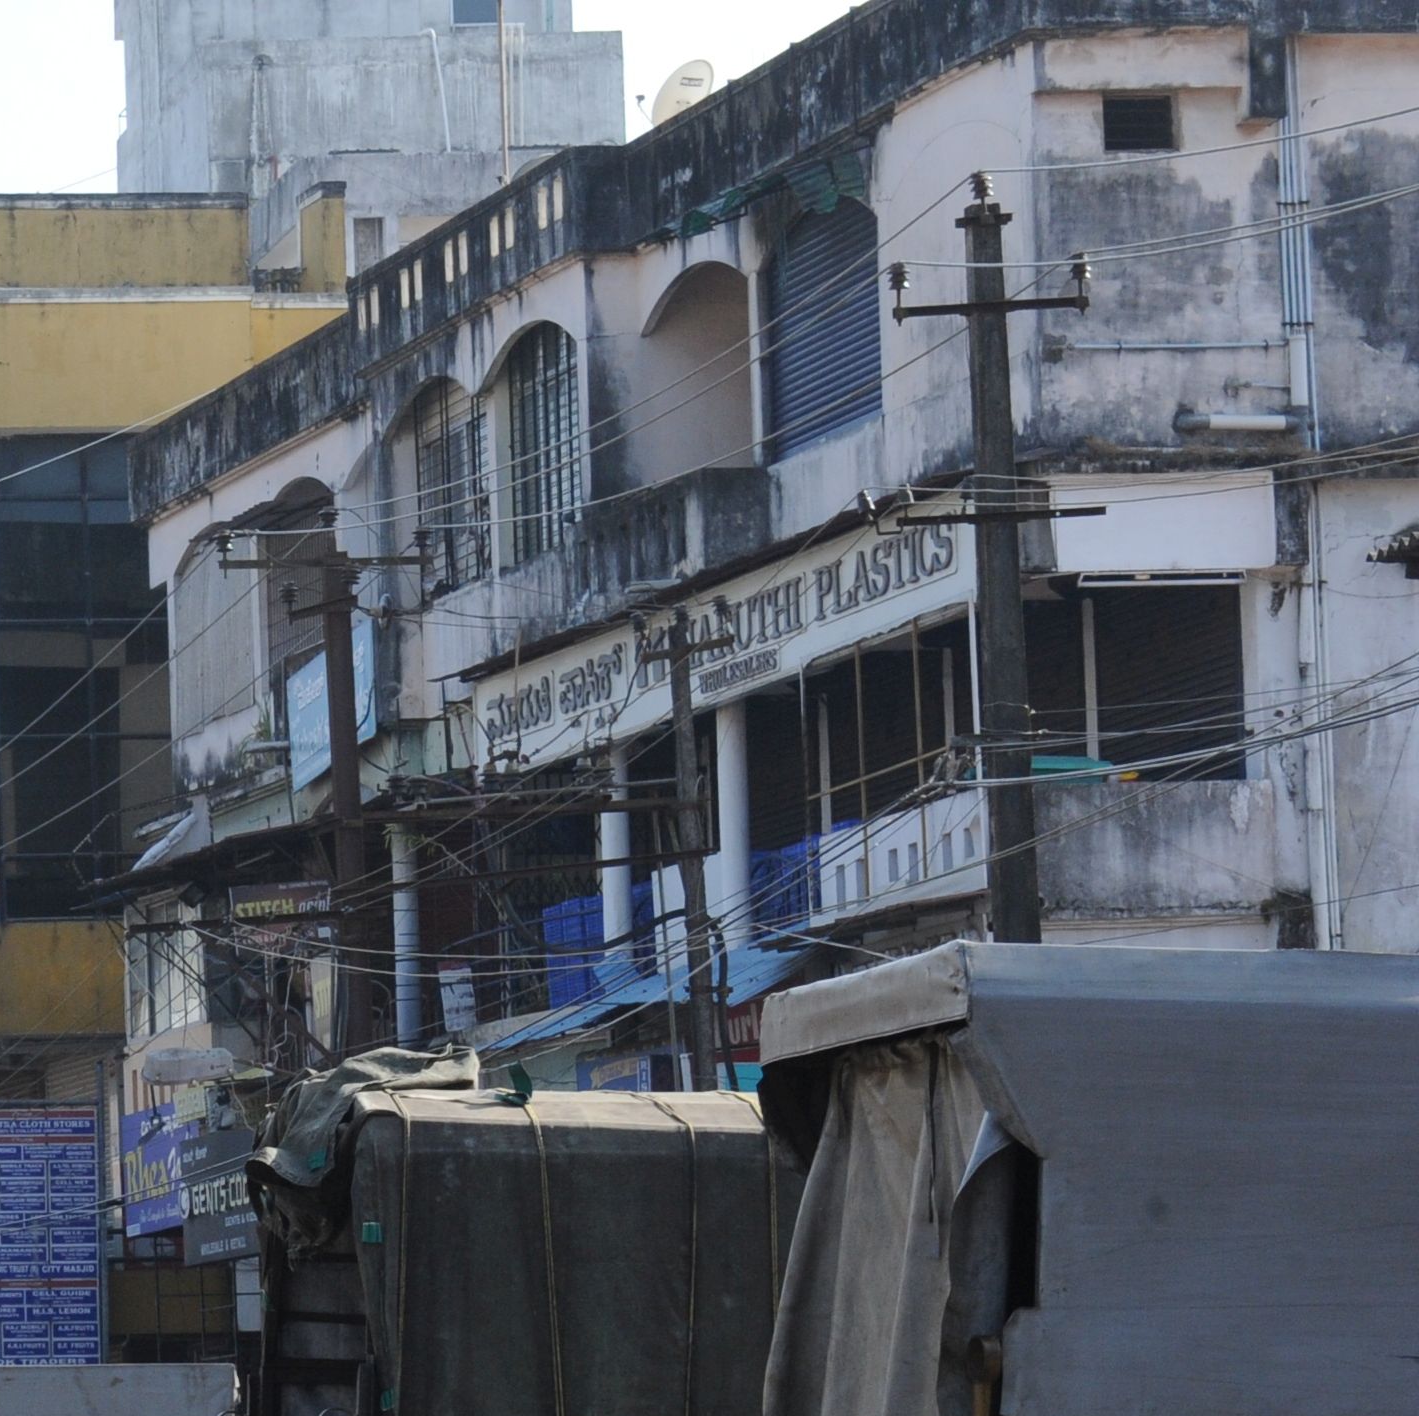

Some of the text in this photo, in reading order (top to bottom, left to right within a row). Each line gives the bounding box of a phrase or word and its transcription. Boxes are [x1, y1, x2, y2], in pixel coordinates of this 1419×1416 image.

[814, 524, 954, 622] PLASTICS
[699, 648, 777, 695] WHOLESALERS
[19, 1120, 51, 1128] CLOTH
[53, 1120, 91, 1128] STORES
[9, 1265, 29, 1273] TRUST
[41, 1265, 61, 1273] CITY
[63, 1265, 95, 1273] MASJID
